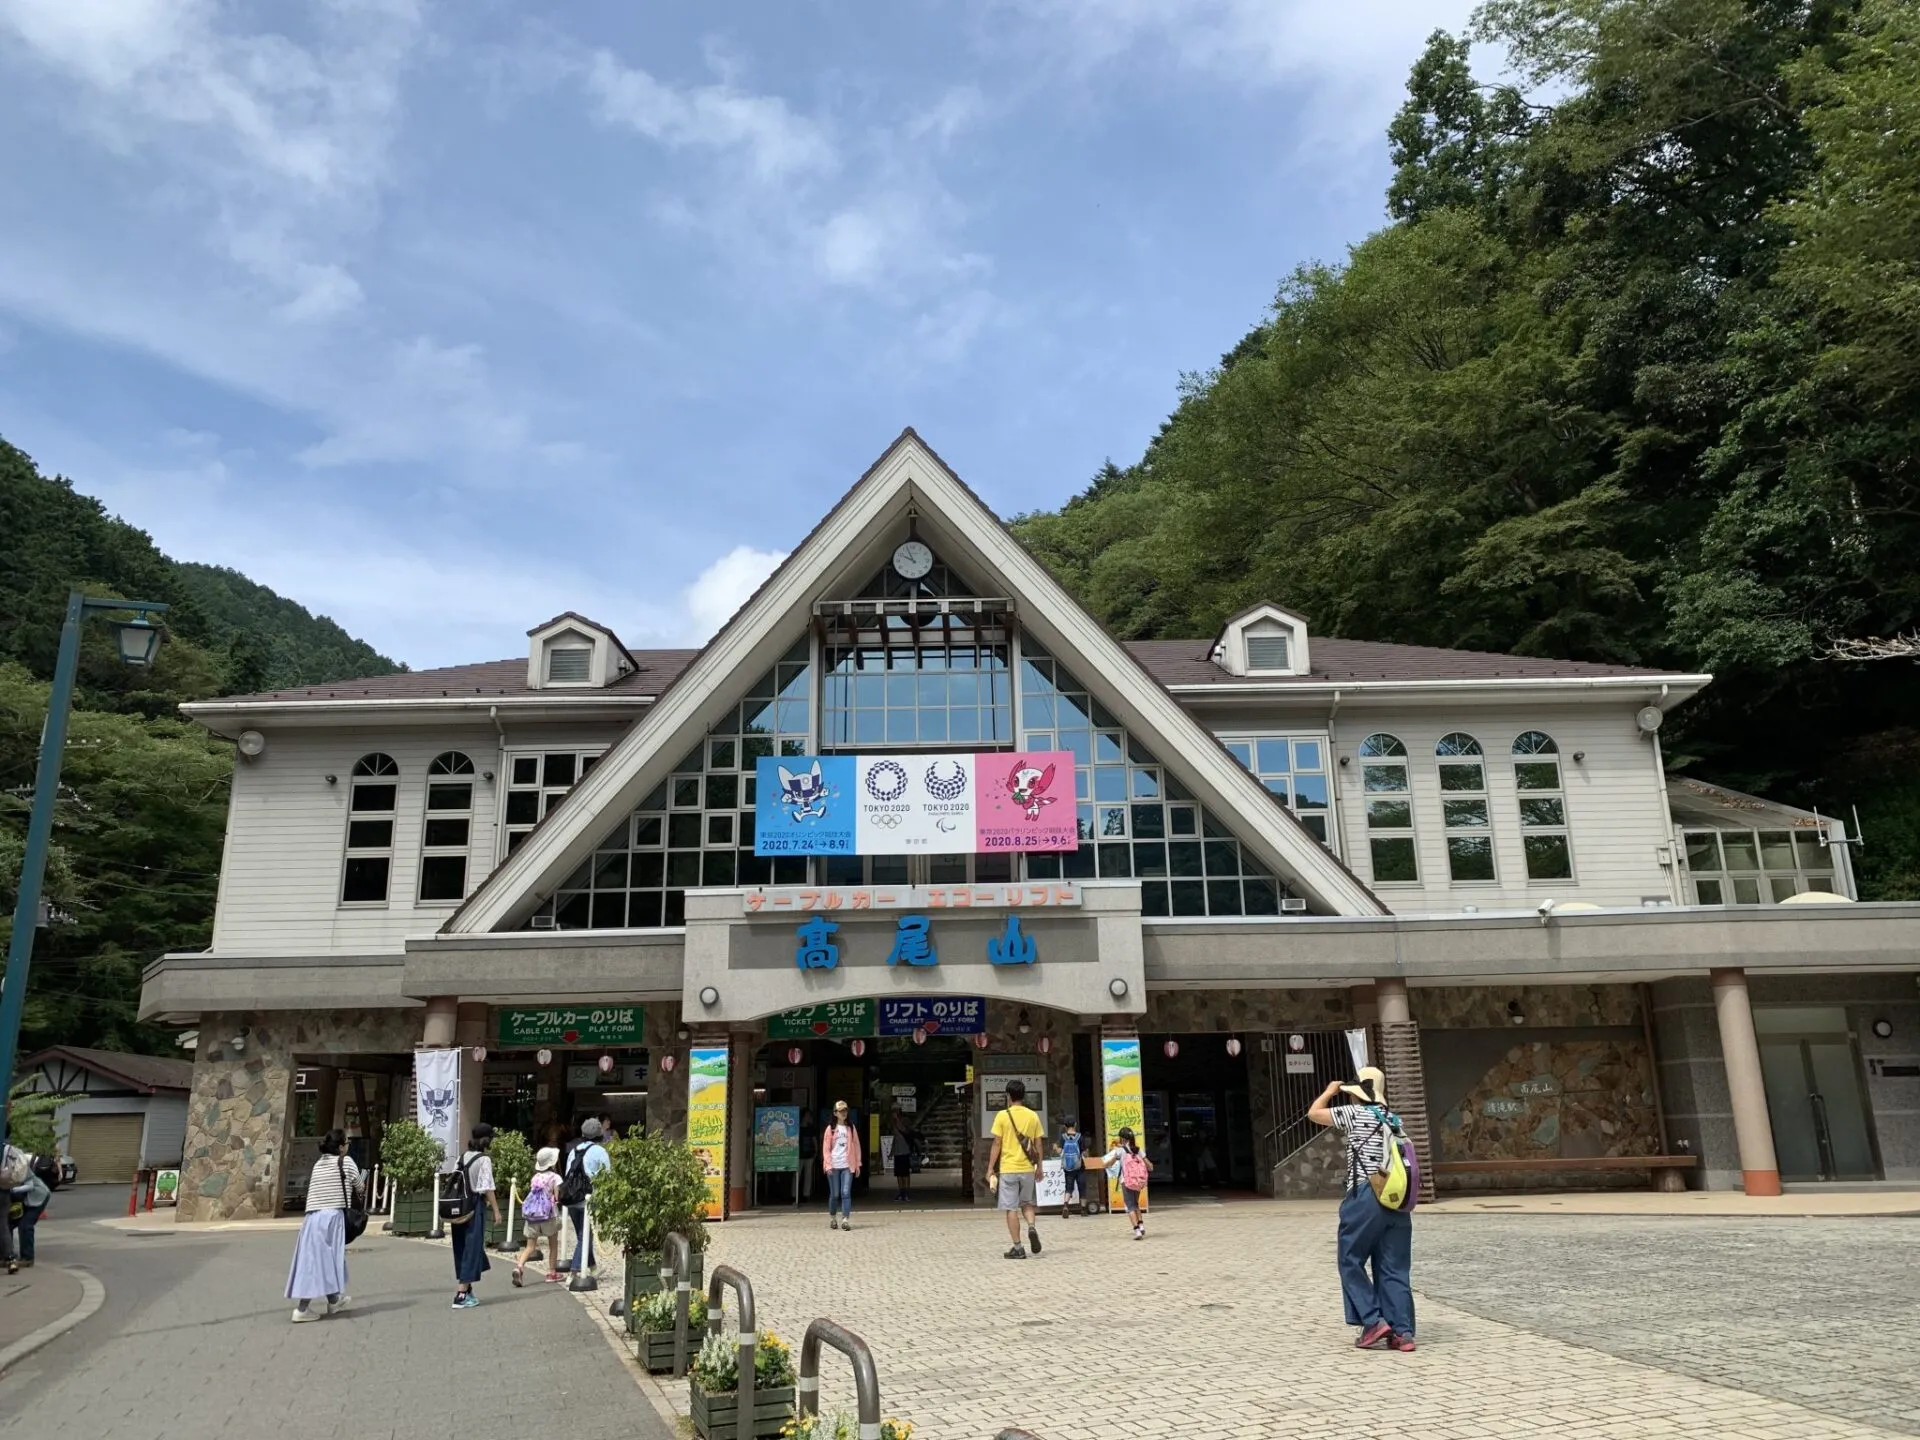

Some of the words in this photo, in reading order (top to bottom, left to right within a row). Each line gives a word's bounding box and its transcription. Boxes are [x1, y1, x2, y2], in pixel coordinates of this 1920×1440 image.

[864, 804, 889, 812] TOKYO
[891, 804, 910, 812] 2020
[923, 803, 948, 812] TOKYO
[950, 803, 969, 811] 2020
[762, 840, 814, 850] 2020.7.24
[985, 836, 1038, 847] 2020.8.25
[747, 888, 896, 911] ケーブルカー
[927, 886, 1074, 908] エコーリフト
[510, 1009, 634, 1026] ケーブルカーのりば
[611, 1025, 635, 1033] FORM
[1043, 1170, 1064, 1178] スタン
